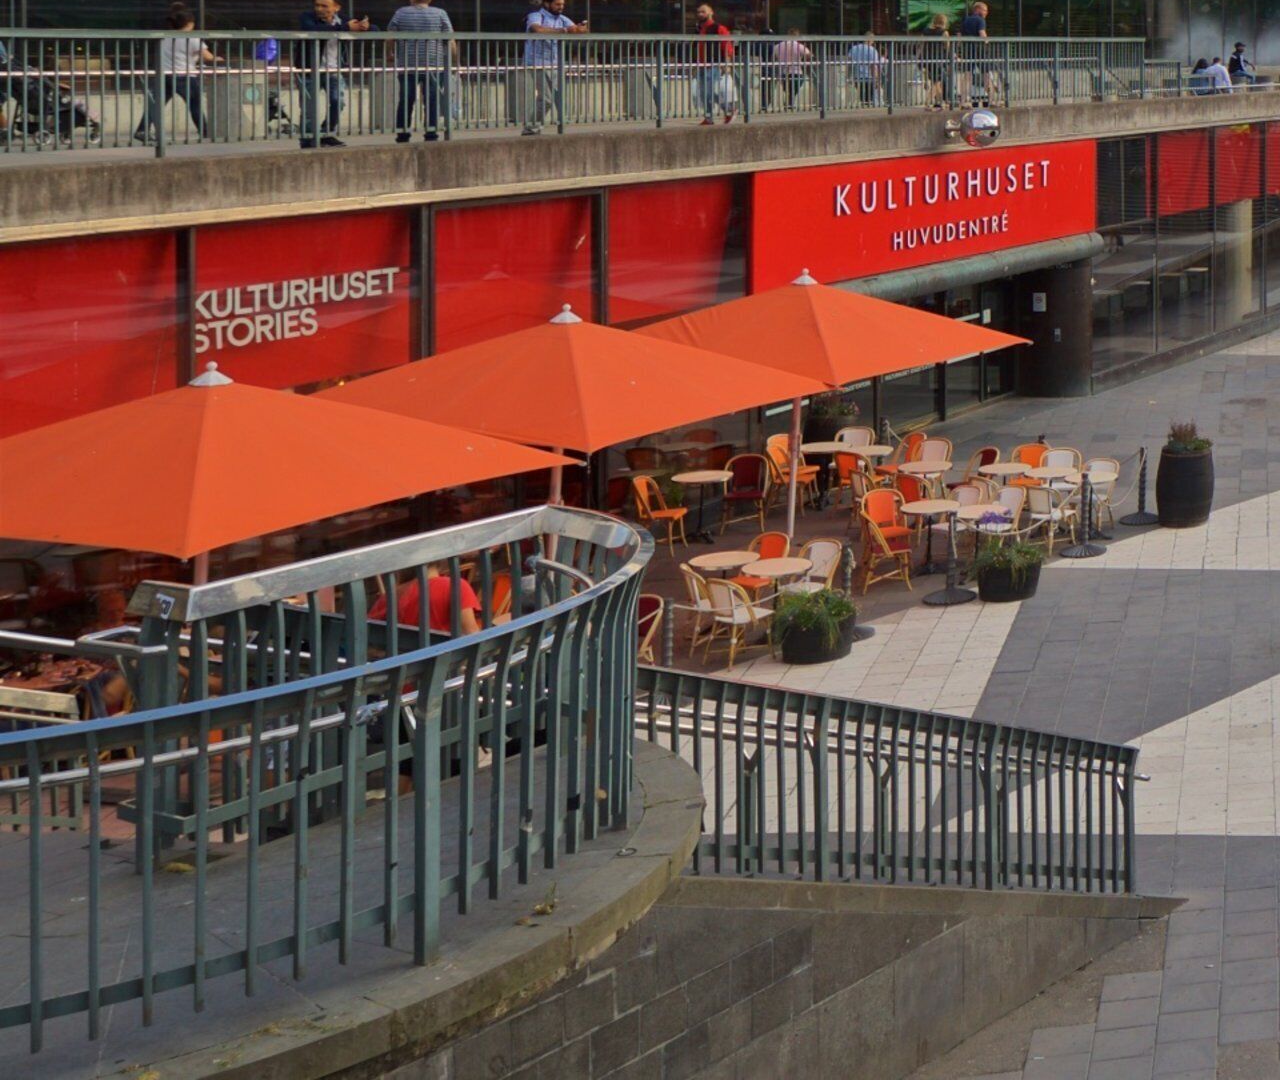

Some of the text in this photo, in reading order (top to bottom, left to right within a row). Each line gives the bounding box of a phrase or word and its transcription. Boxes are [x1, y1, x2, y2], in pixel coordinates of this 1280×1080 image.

[835, 160, 1051, 217] KULTURHUSET
[892, 210, 1009, 252] HUVUDENTRÉ
[195, 266, 400, 320] KULTURHUSET
[195, 307, 319, 354] STORIES
